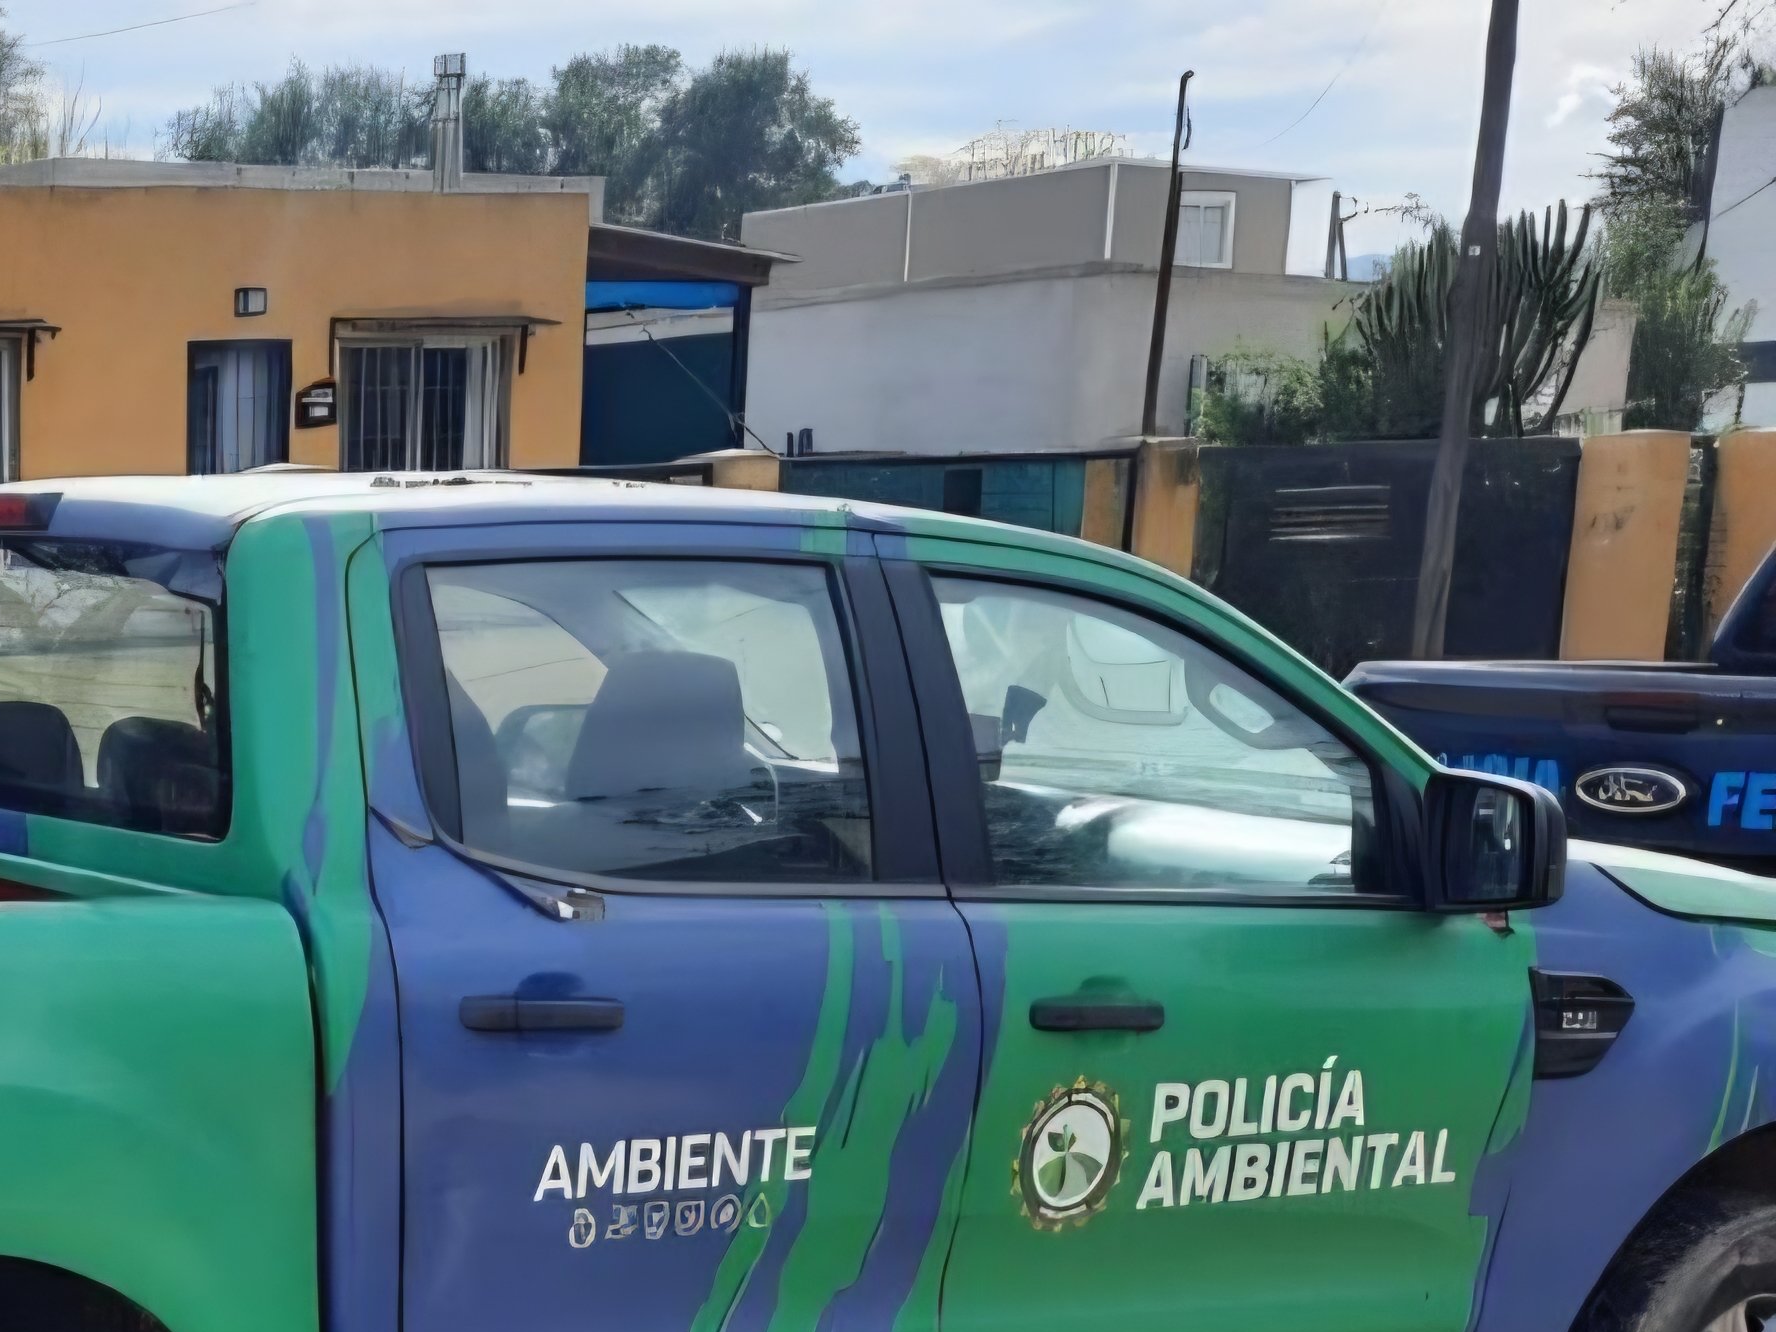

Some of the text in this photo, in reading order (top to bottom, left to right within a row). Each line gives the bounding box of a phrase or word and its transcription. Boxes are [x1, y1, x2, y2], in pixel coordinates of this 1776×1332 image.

[1150, 1054, 1365, 1143] POLICÍA
[533, 1126, 818, 1202] AMBIENTE
[1135, 1128, 1456, 1210] AMBIENTAL
